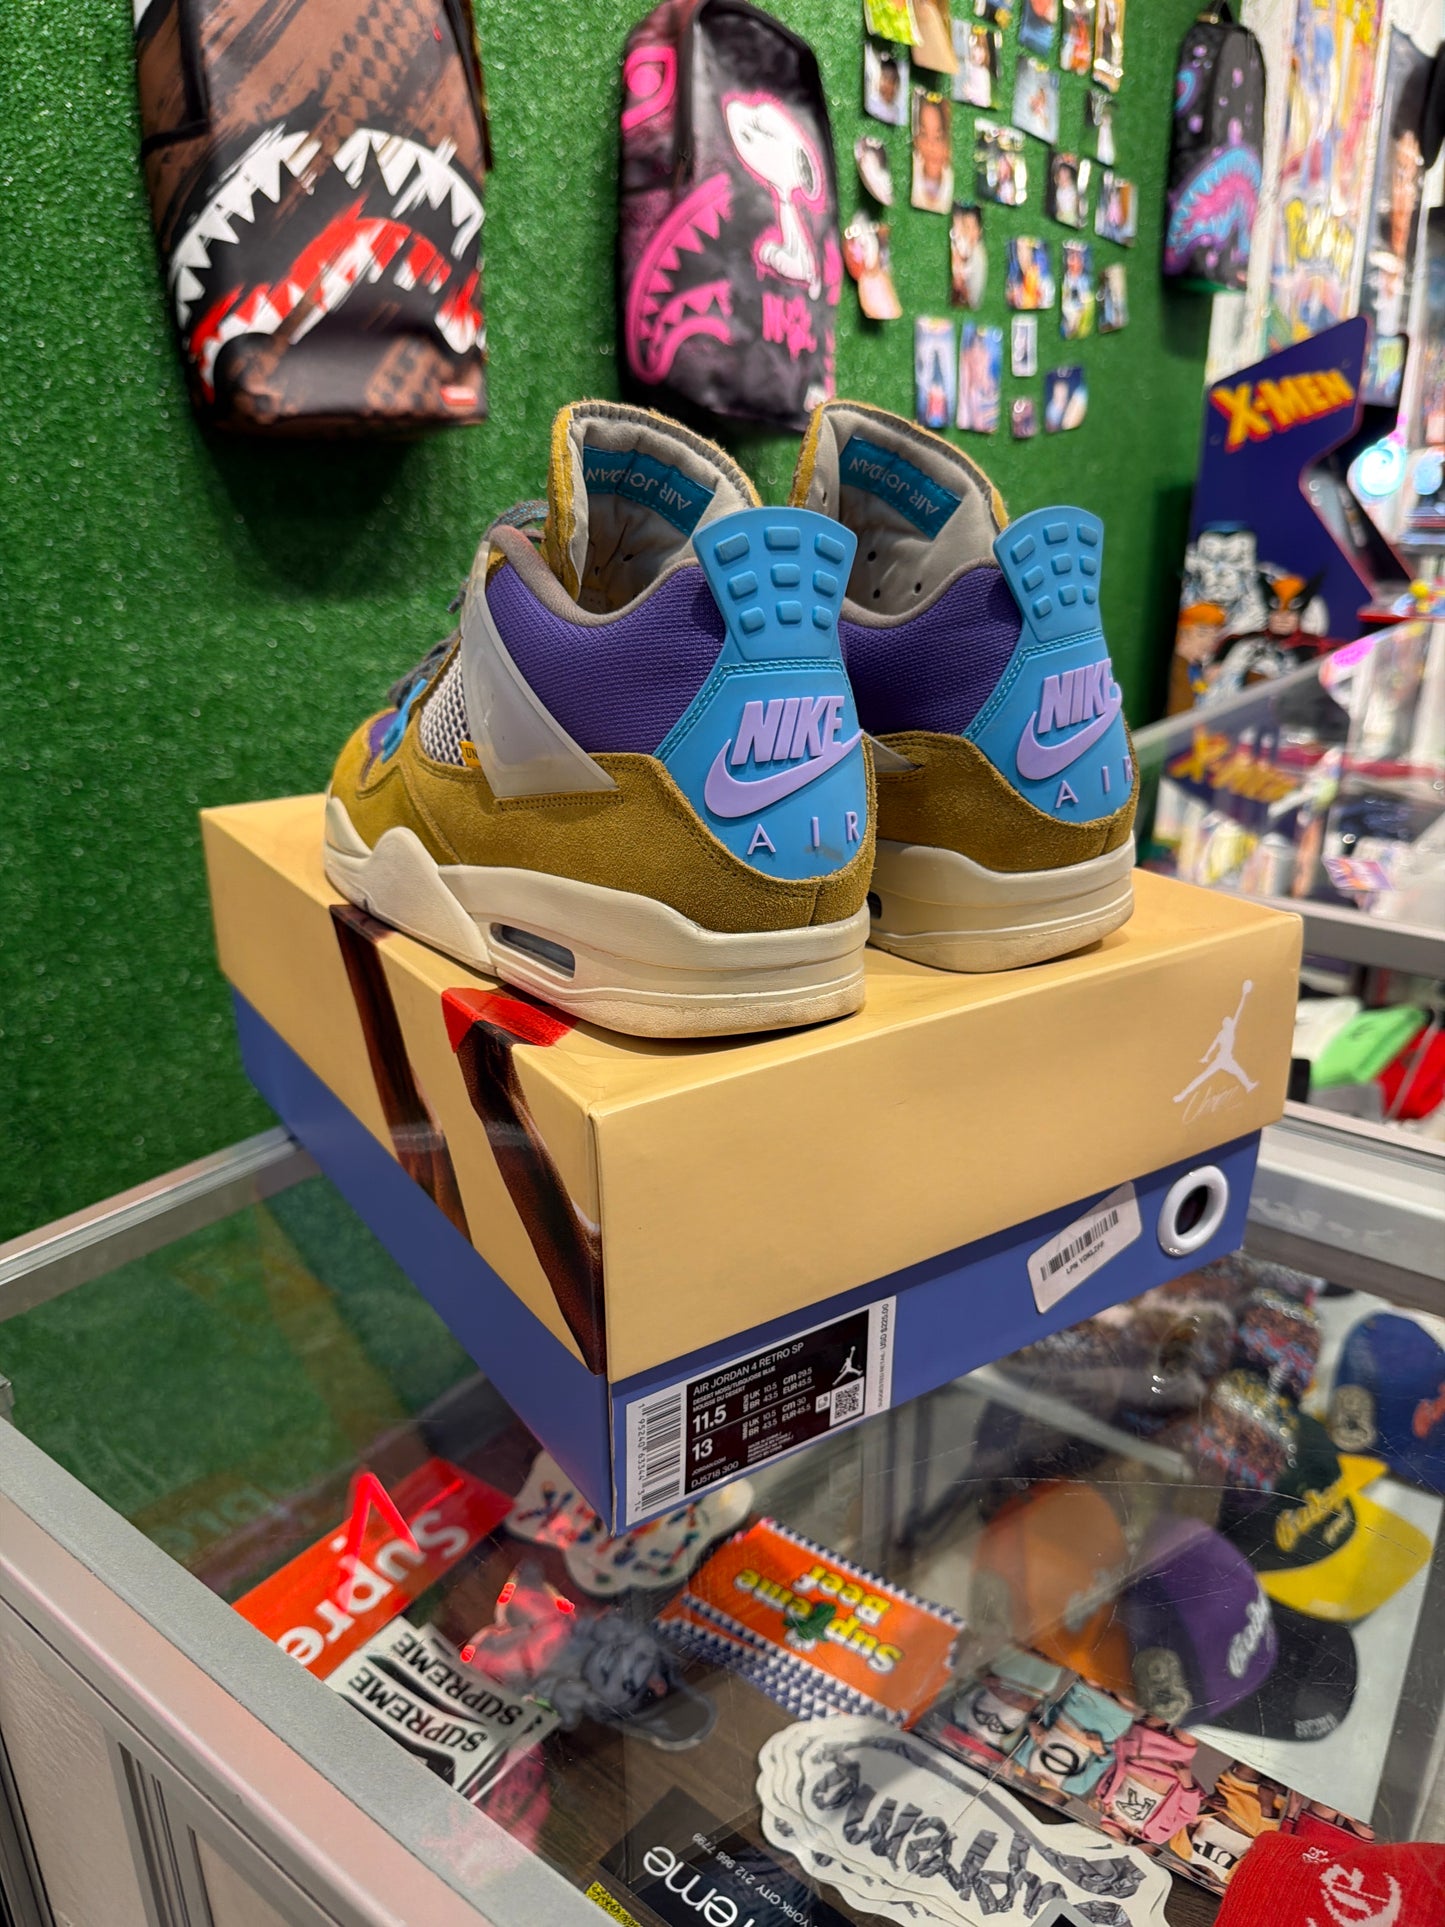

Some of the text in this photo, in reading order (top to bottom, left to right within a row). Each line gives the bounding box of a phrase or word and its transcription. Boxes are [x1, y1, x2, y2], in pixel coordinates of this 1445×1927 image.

[1210, 369, 1356, 454] X-MEN
[659, 482, 692, 510] AIR
[908, 490, 940, 515] AIR
[1037, 658, 1116, 734] NIKE
[730, 695, 845, 766] NIKE
[1055, 755, 1133, 809] AIR
[747, 811, 860, 855] AIR
[693, 1342, 805, 1396] AIR JORDAN 4 RETRO SP
[749, 1366, 813, 1400] UK 10.5 cm 29.5
[748, 1396, 807, 1427] UK 10.5 cm 30
[749, 1376, 812, 1409] BR 43.5 EUR 45.5
[638, 1418, 646, 1448] 95240
[692, 1404, 727, 1434] 11.5
[748, 1426, 760, 1437] BR
[762, 1418, 778, 1431] 43.5
[781, 1410, 797, 1423] EUR
[796, 1403, 812, 1416] 45.5
[638, 1453, 646, 1480] 63344
[692, 1438, 713, 1461] 13
[691, 1460, 739, 1489] DJ5718 300
[792, 1564, 891, 1626] Beef
[391, 1632, 523, 1726] SUPREME
[348, 1667, 488, 1752] SUPREME
[642, 1846, 755, 1927] eme
[692, 1832, 811, 1927] YORK CITY 212 966 7799
